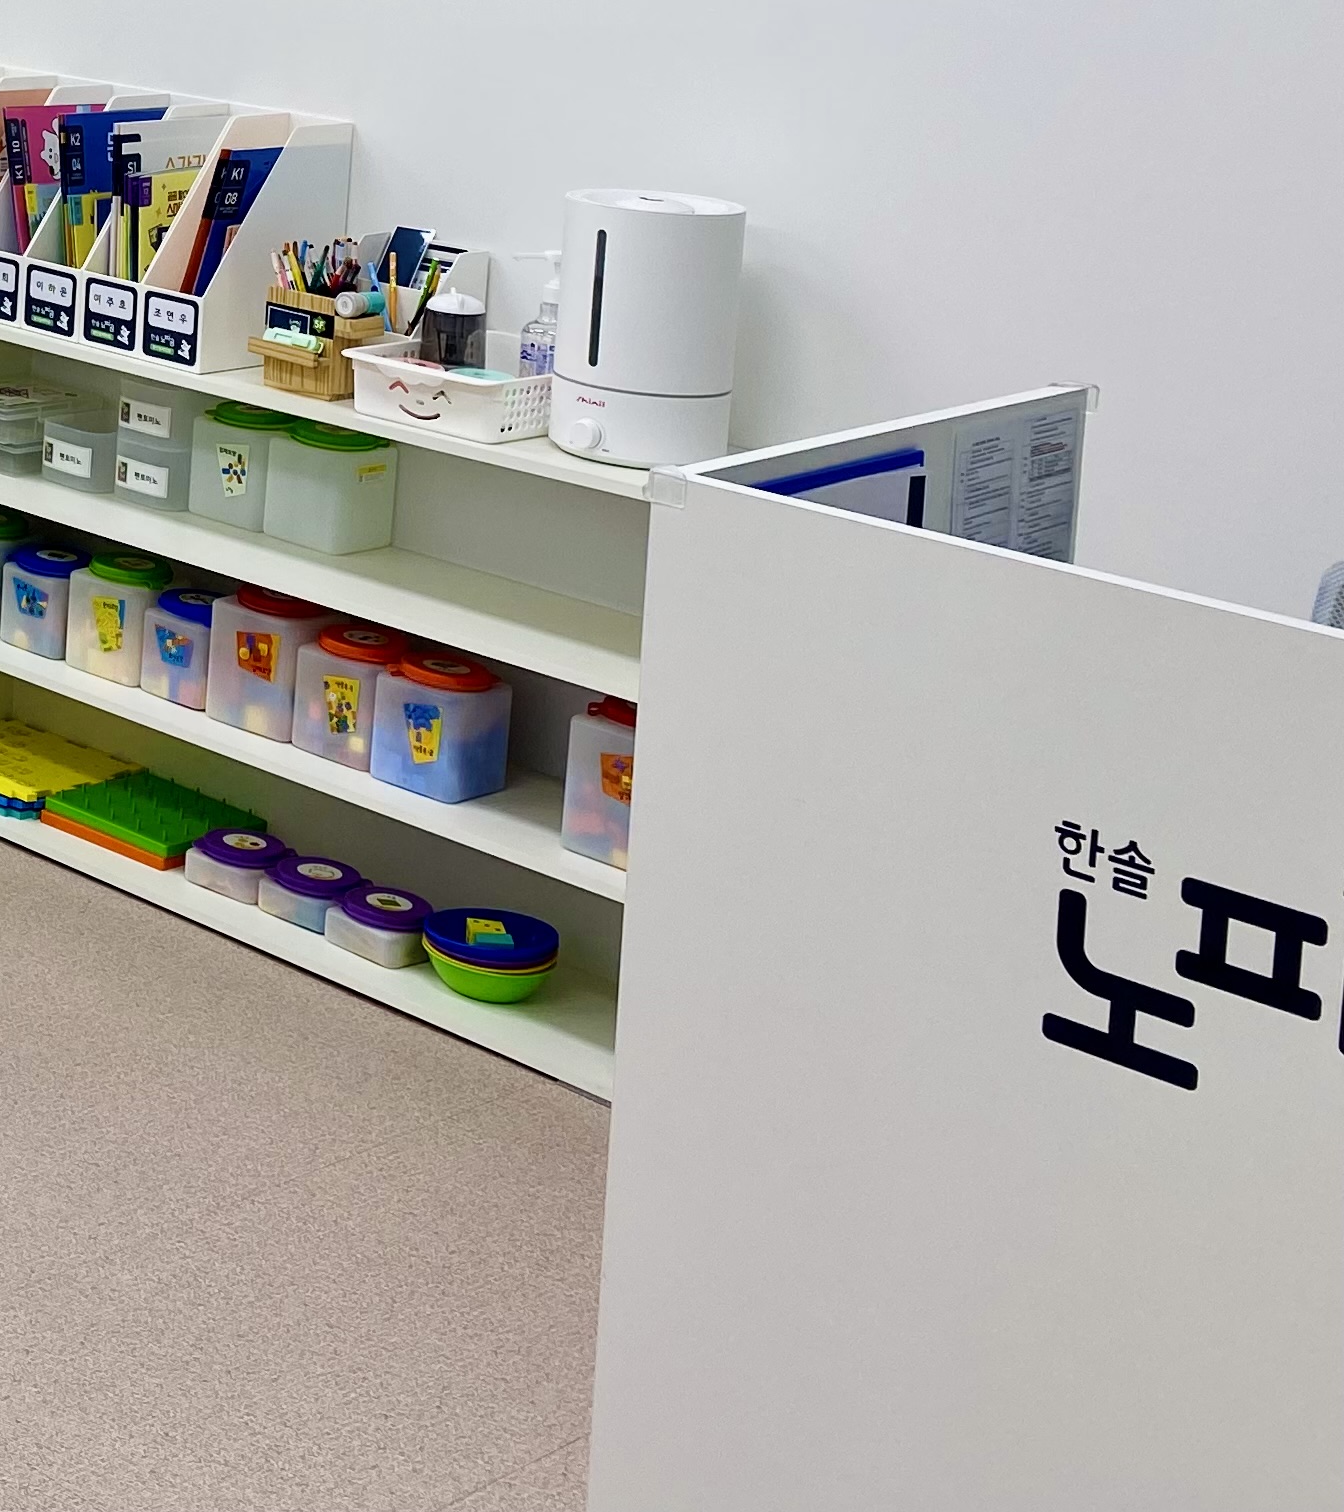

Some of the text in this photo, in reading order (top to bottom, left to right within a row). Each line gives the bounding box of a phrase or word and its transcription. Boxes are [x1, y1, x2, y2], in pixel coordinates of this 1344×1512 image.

[70, 132, 81, 146] K2
[12, 140, 21, 153] 10
[16, 164, 24, 180] K1
[231, 168, 245, 180] K1
[225, 192, 239, 205] 08
[1054, 820, 1155, 900] 한솔
